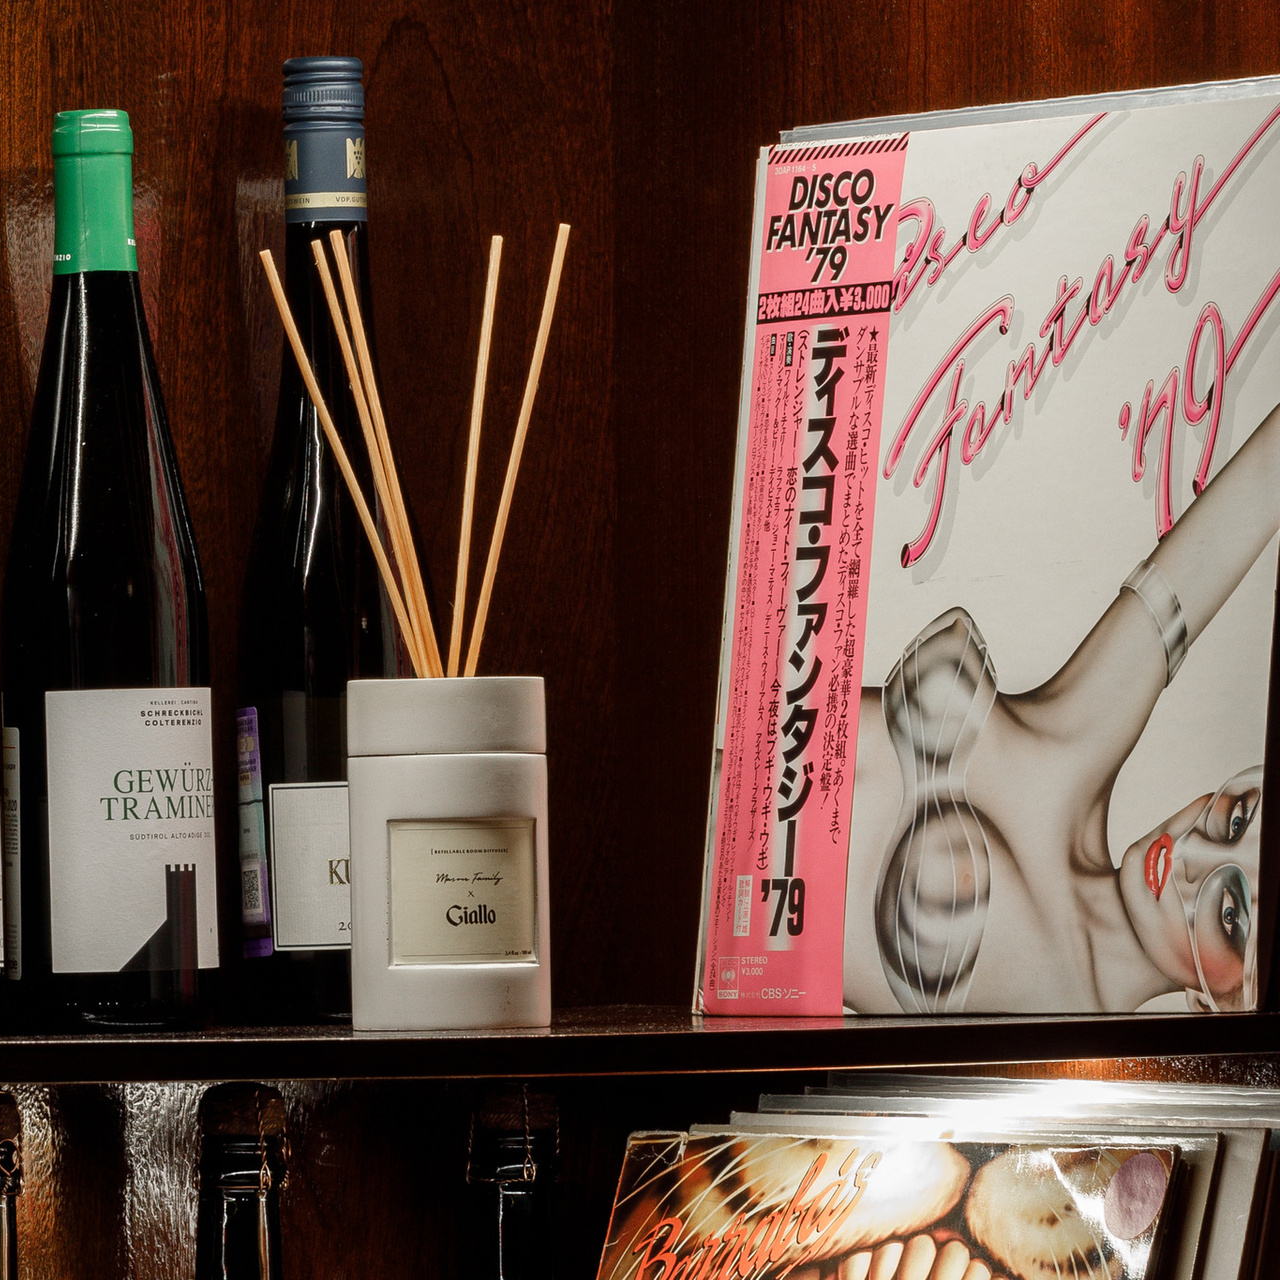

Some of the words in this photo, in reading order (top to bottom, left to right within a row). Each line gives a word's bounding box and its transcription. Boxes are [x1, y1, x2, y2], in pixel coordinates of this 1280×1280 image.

[789, 169, 876, 212] DISCO
[766, 203, 895, 253] FANTASY
[140, 709, 204, 717] SCHRECKBICHL
[144, 719, 202, 727] COLTERENZIO
[129, 833, 168, 841] SÜDTIROL
[472, 871, 504, 886] Family
[446, 904, 496, 927] Giallo
[741, 956, 768, 965] STEREO
